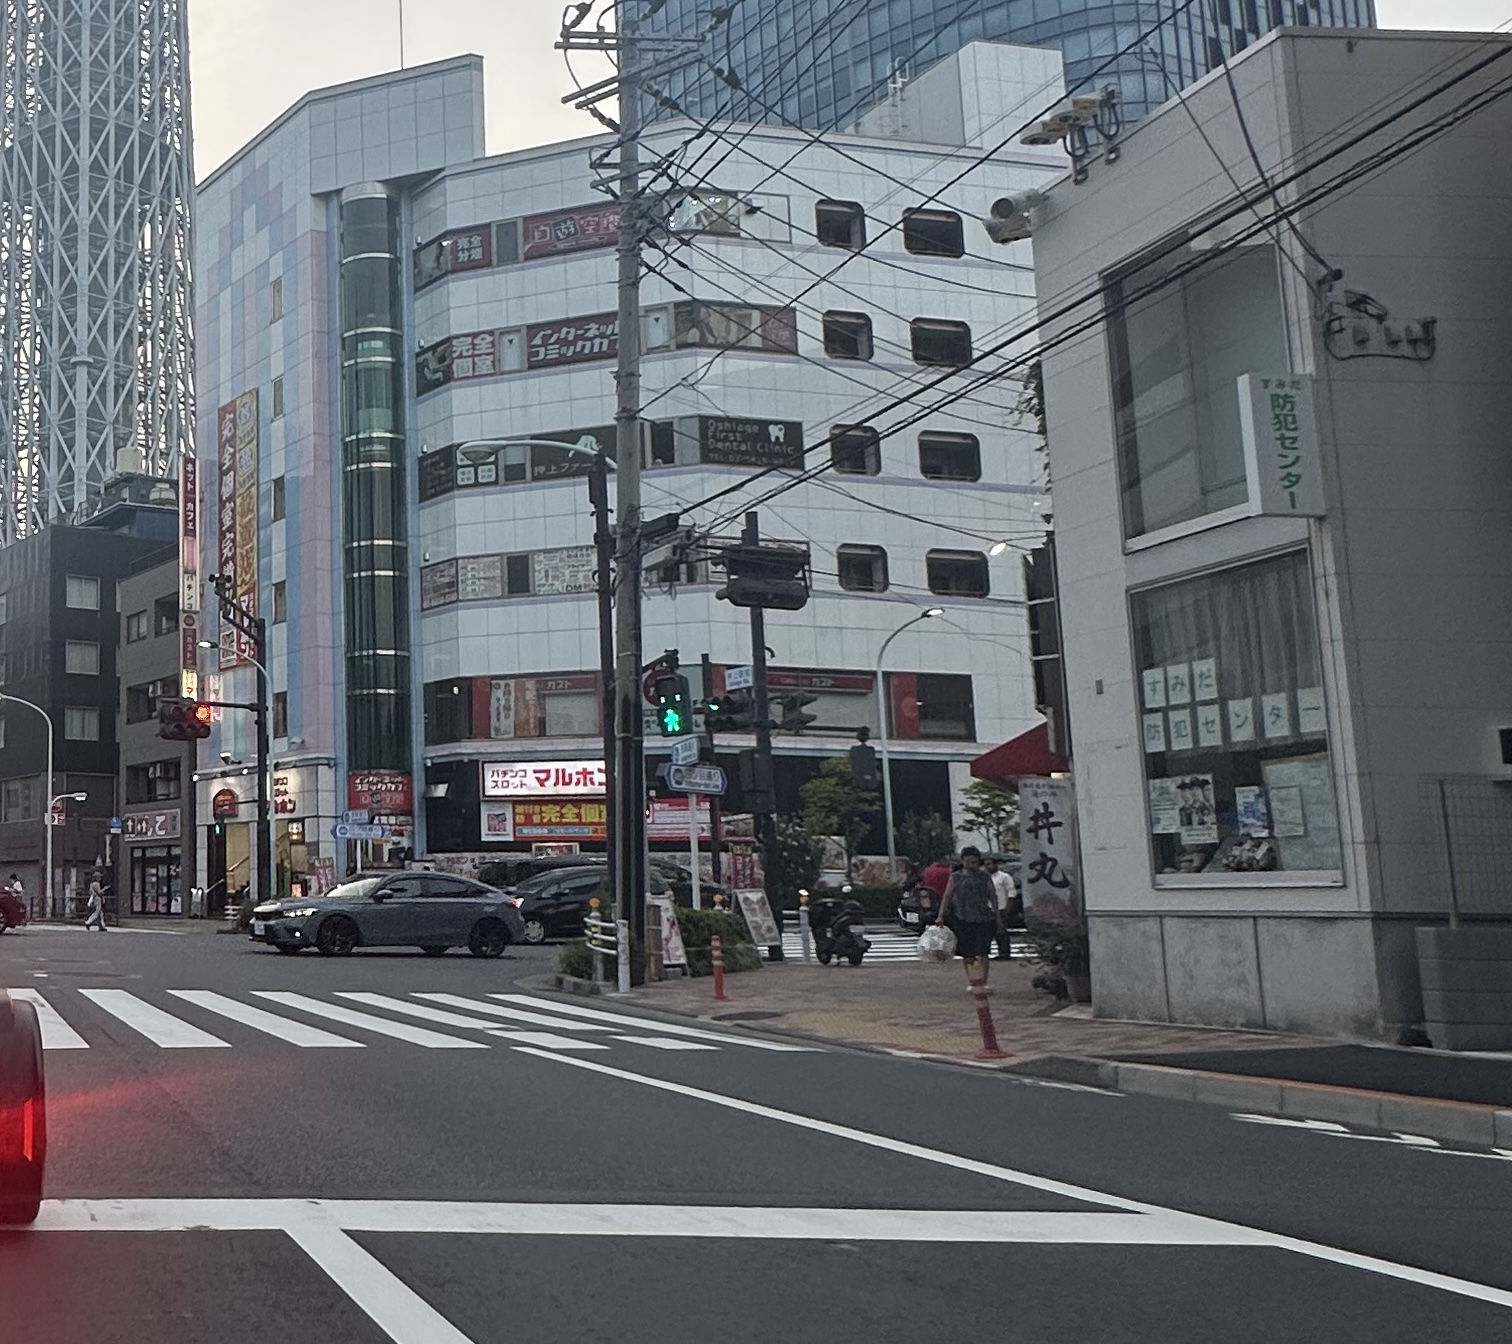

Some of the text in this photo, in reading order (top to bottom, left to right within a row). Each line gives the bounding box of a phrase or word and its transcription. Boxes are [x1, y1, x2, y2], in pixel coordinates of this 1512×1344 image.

[531, 322, 618, 346] インターネッ
[452, 333, 494, 357] 完全
[708, 419, 760, 433] Oshiage
[708, 428, 744, 442] First
[708, 439, 795, 455] Dental Clinic
[1270, 394, 1303, 510] 防犯センター
[1147, 668, 1212, 697] すみだ
[1146, 705, 1321, 742] 防犯センター
[491, 769, 528, 779] パチンコ
[491, 779, 528, 790] スロット
